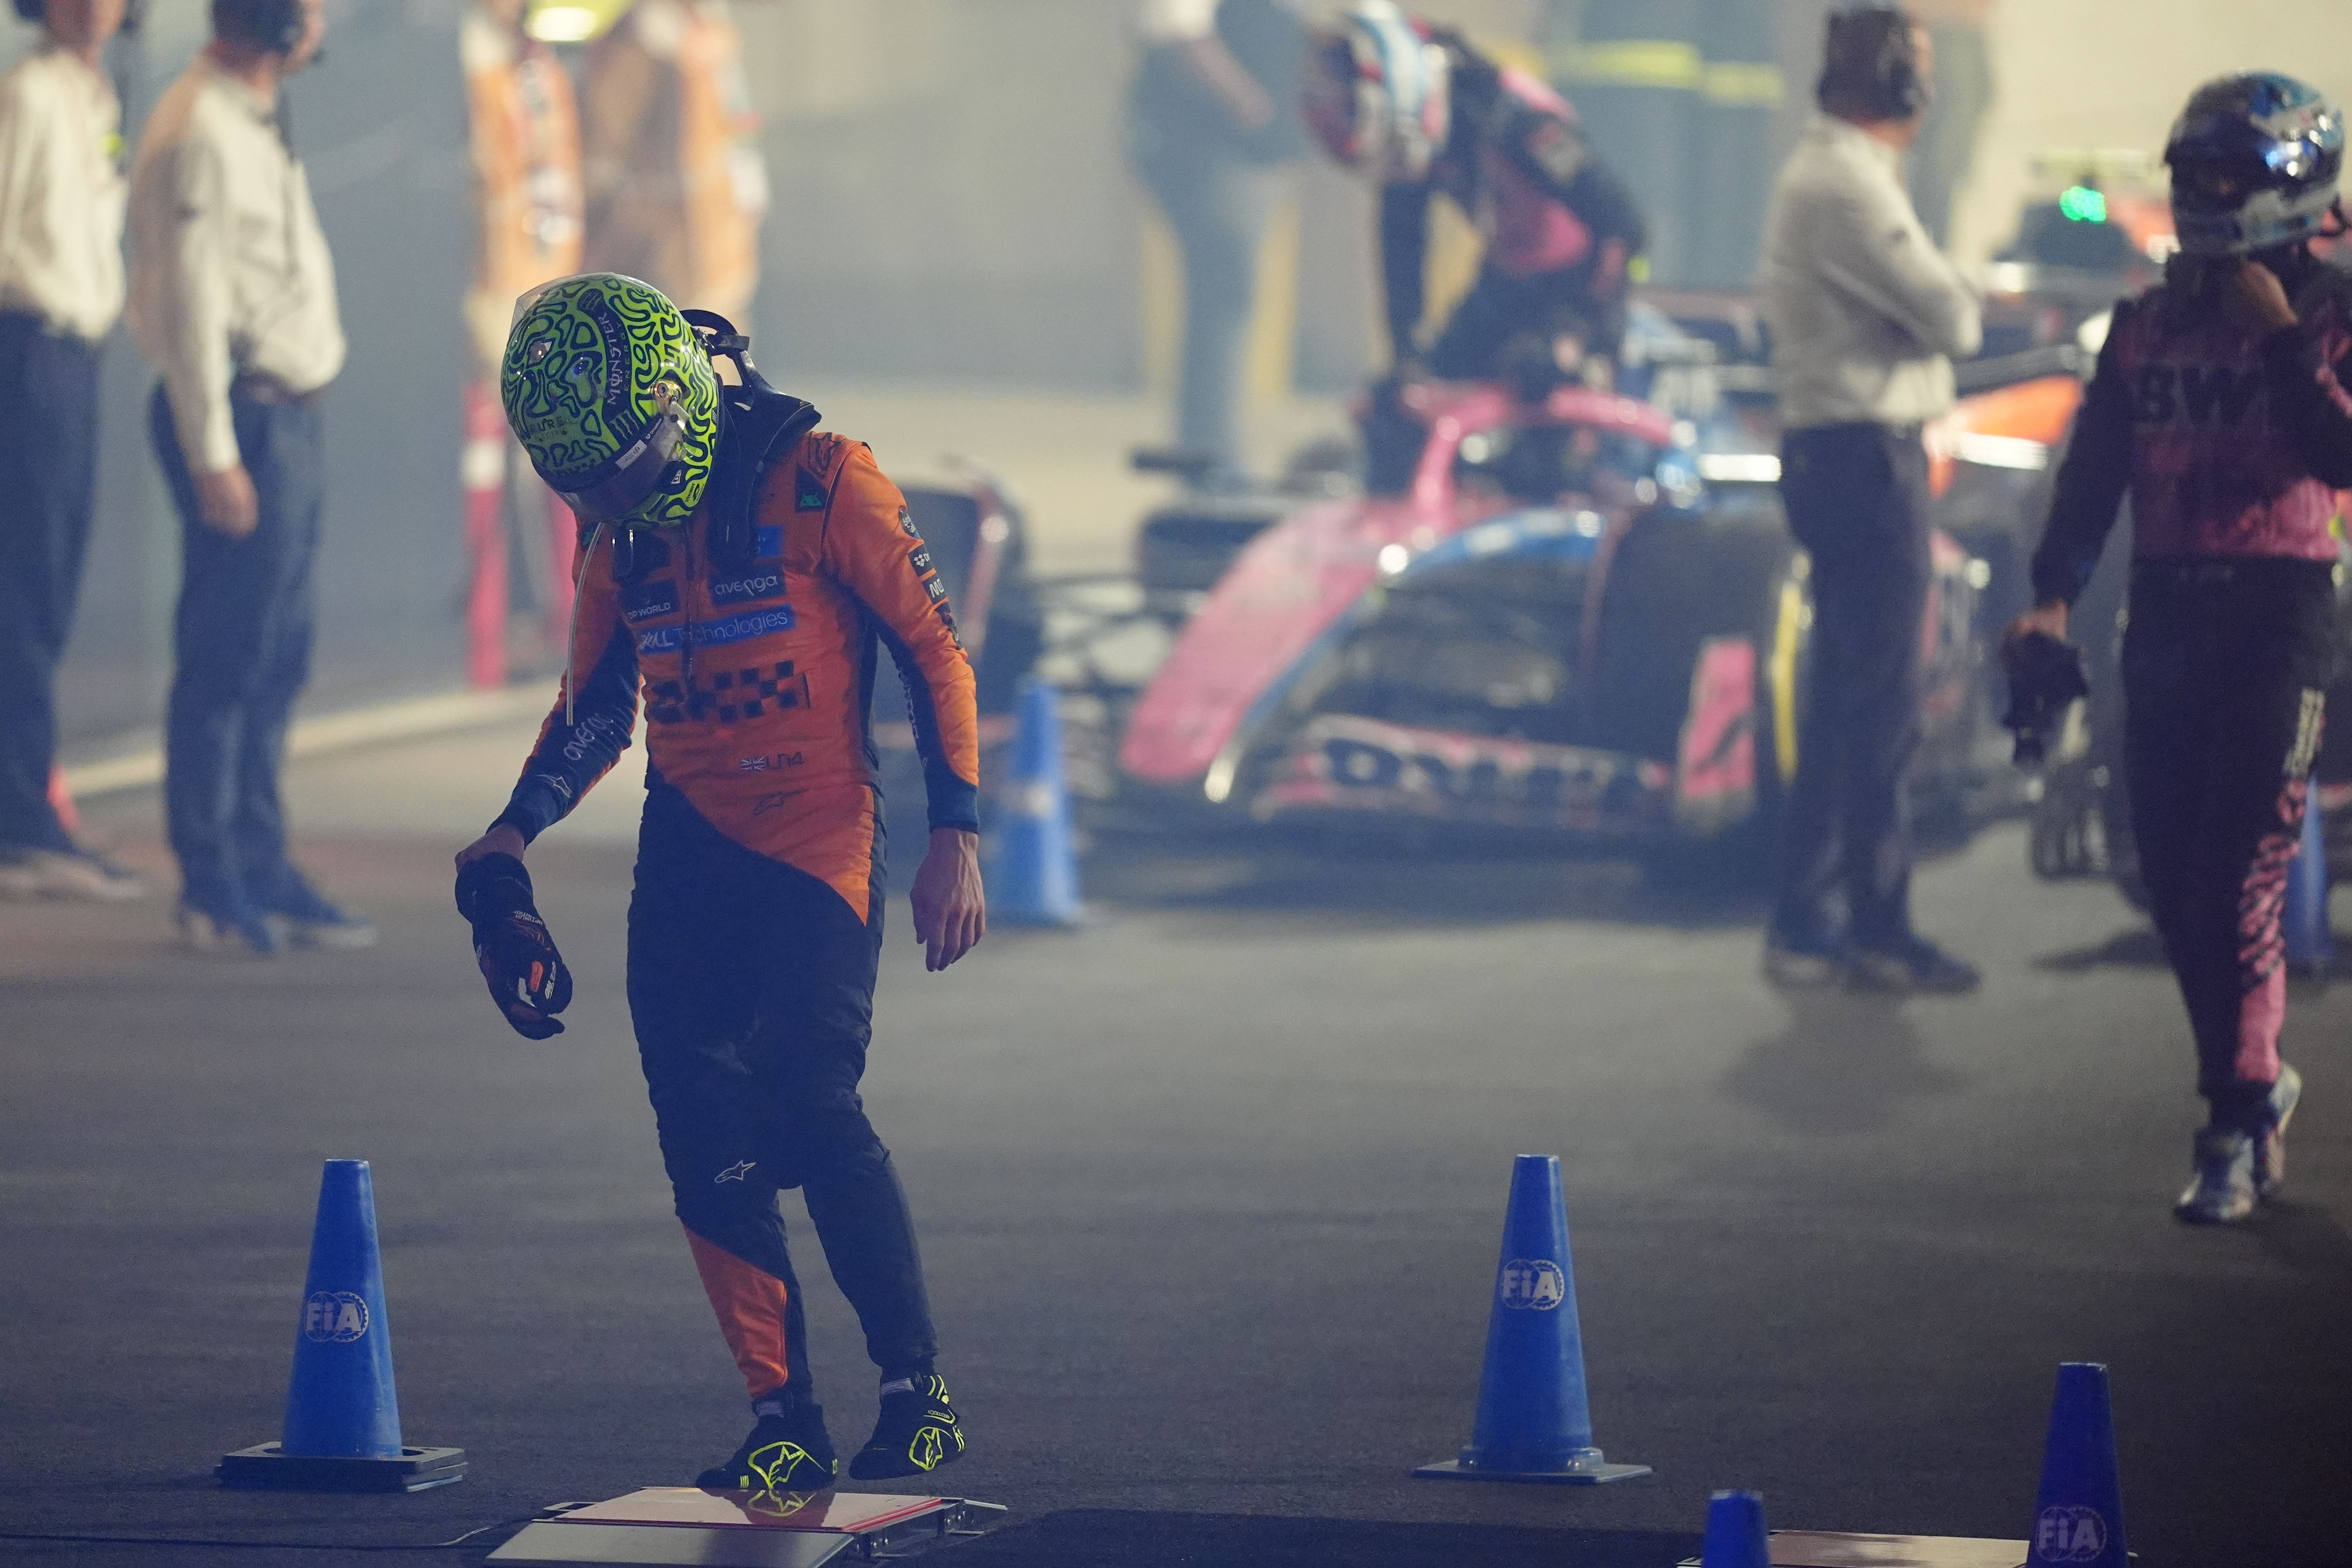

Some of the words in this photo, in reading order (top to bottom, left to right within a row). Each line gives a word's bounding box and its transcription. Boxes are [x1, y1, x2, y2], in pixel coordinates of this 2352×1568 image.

[598, 312, 621, 405] MONSTER
[616, 323, 630, 391] ENERGY
[715, 575, 778, 596] avenga
[638, 603, 671, 616] WORLD
[674, 612, 788, 642] Tchnologies
